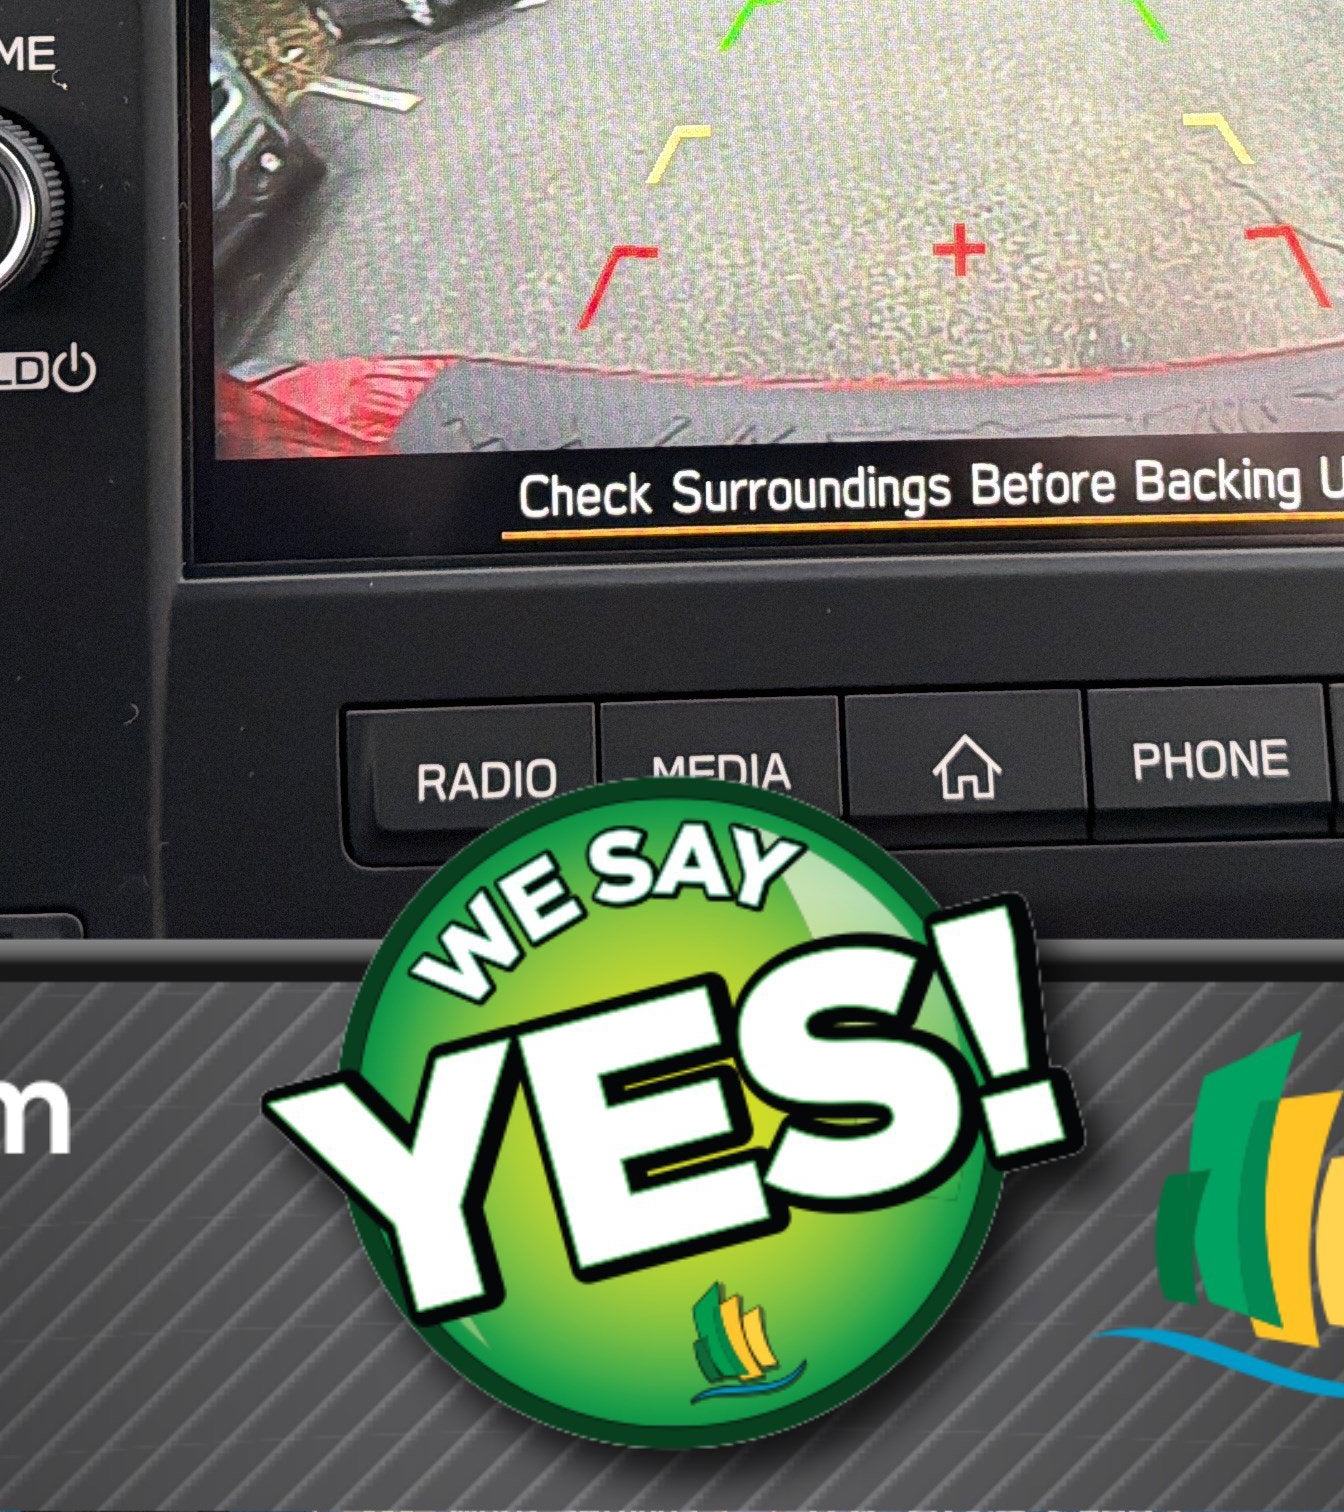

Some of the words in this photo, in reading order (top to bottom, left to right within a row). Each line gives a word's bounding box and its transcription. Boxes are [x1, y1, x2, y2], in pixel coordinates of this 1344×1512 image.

[519, 472, 654, 519] Check
[672, 464, 953, 519] Surroundings
[970, 461, 1117, 506] Before
[1134, 457, 1302, 511] Backing
[417, 758, 558, 802] RADIO
[1132, 738, 1290, 781] PHONE
